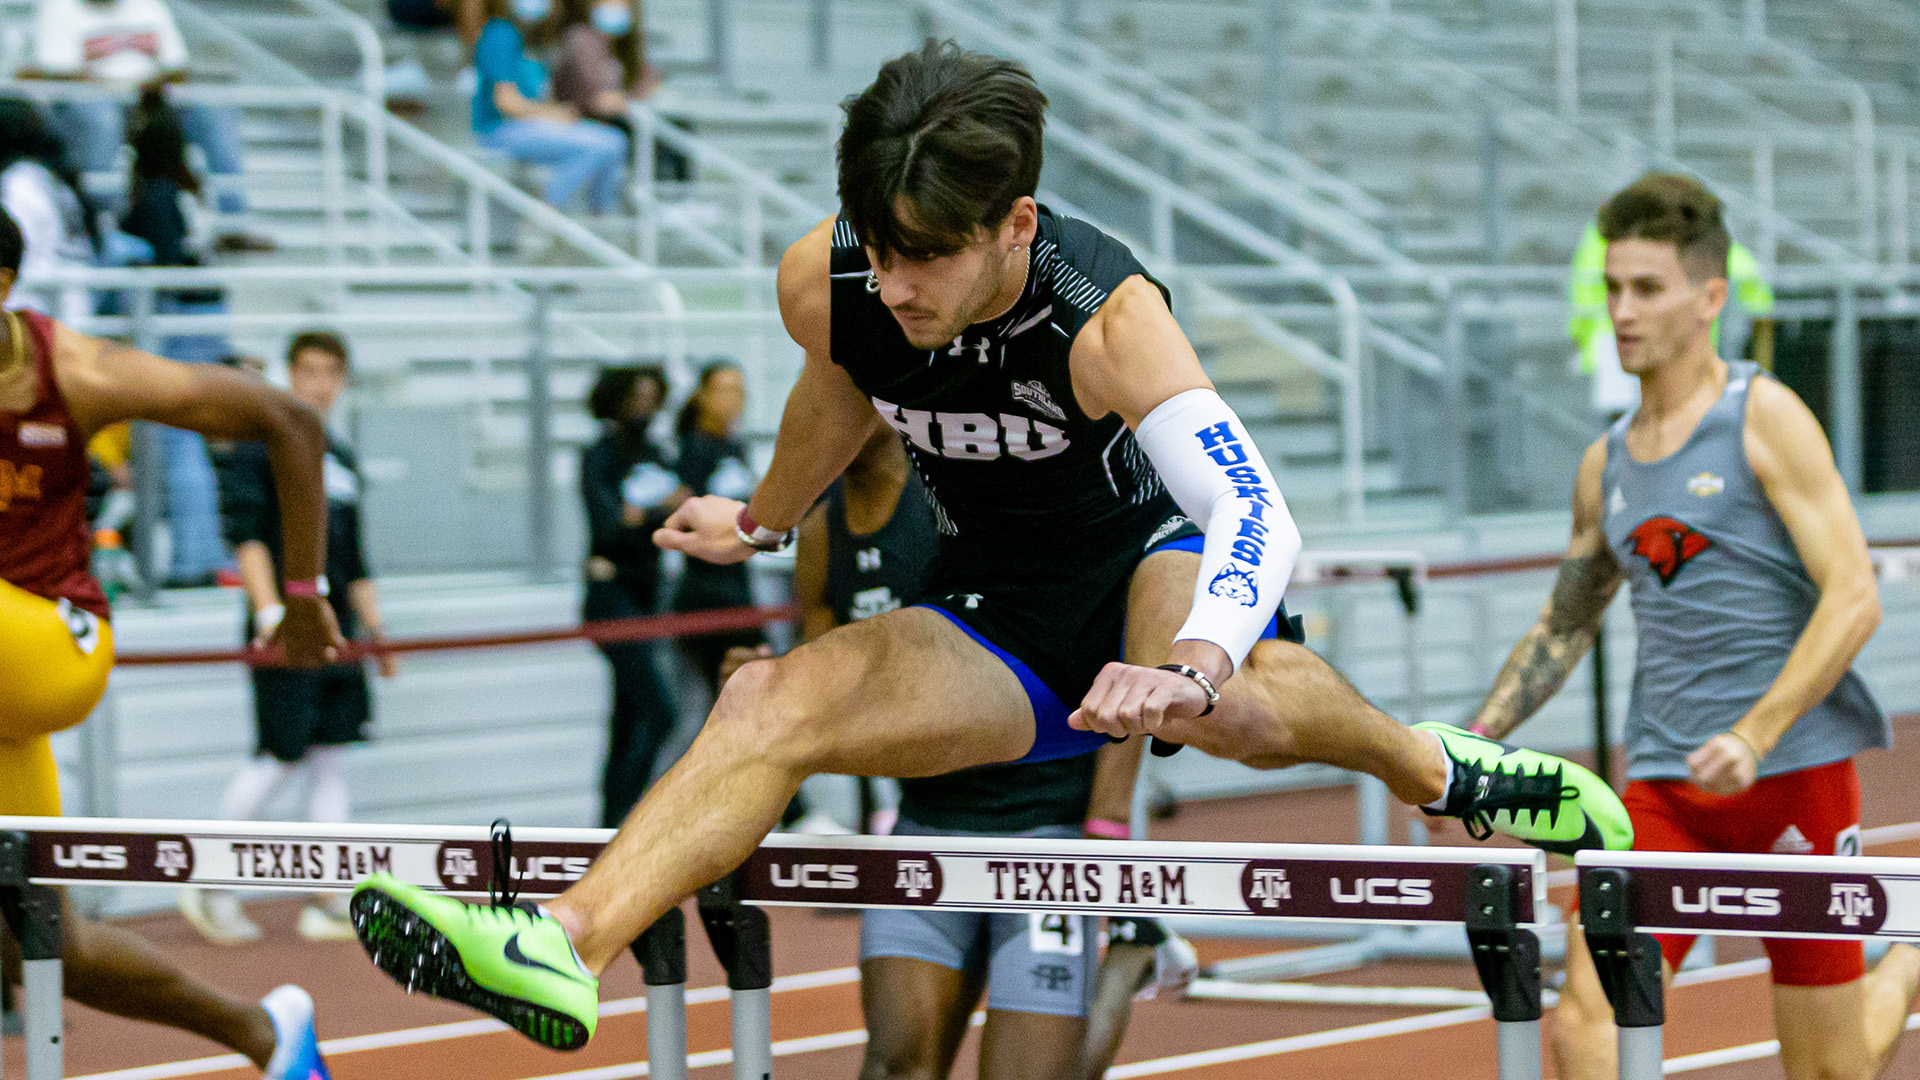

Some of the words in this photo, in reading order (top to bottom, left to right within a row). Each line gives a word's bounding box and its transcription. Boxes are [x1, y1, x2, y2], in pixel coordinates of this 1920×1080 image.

[872, 396, 1071, 461] HBU
[1194, 421, 1273, 566] HUSKIES
[53, 845, 127, 869] UCS
[230, 843, 323, 880] TEXAS
[336, 845, 392, 880] A&M
[510, 856, 590, 881] UCS
[770, 863, 859, 889] UCS
[987, 861, 1102, 902] TEXAS
[1116, 864, 1190, 905] A&M
[1330, 878, 1433, 904] UCS
[1671, 885, 1781, 915] UCS
[1040, 914, 1073, 946] 4
